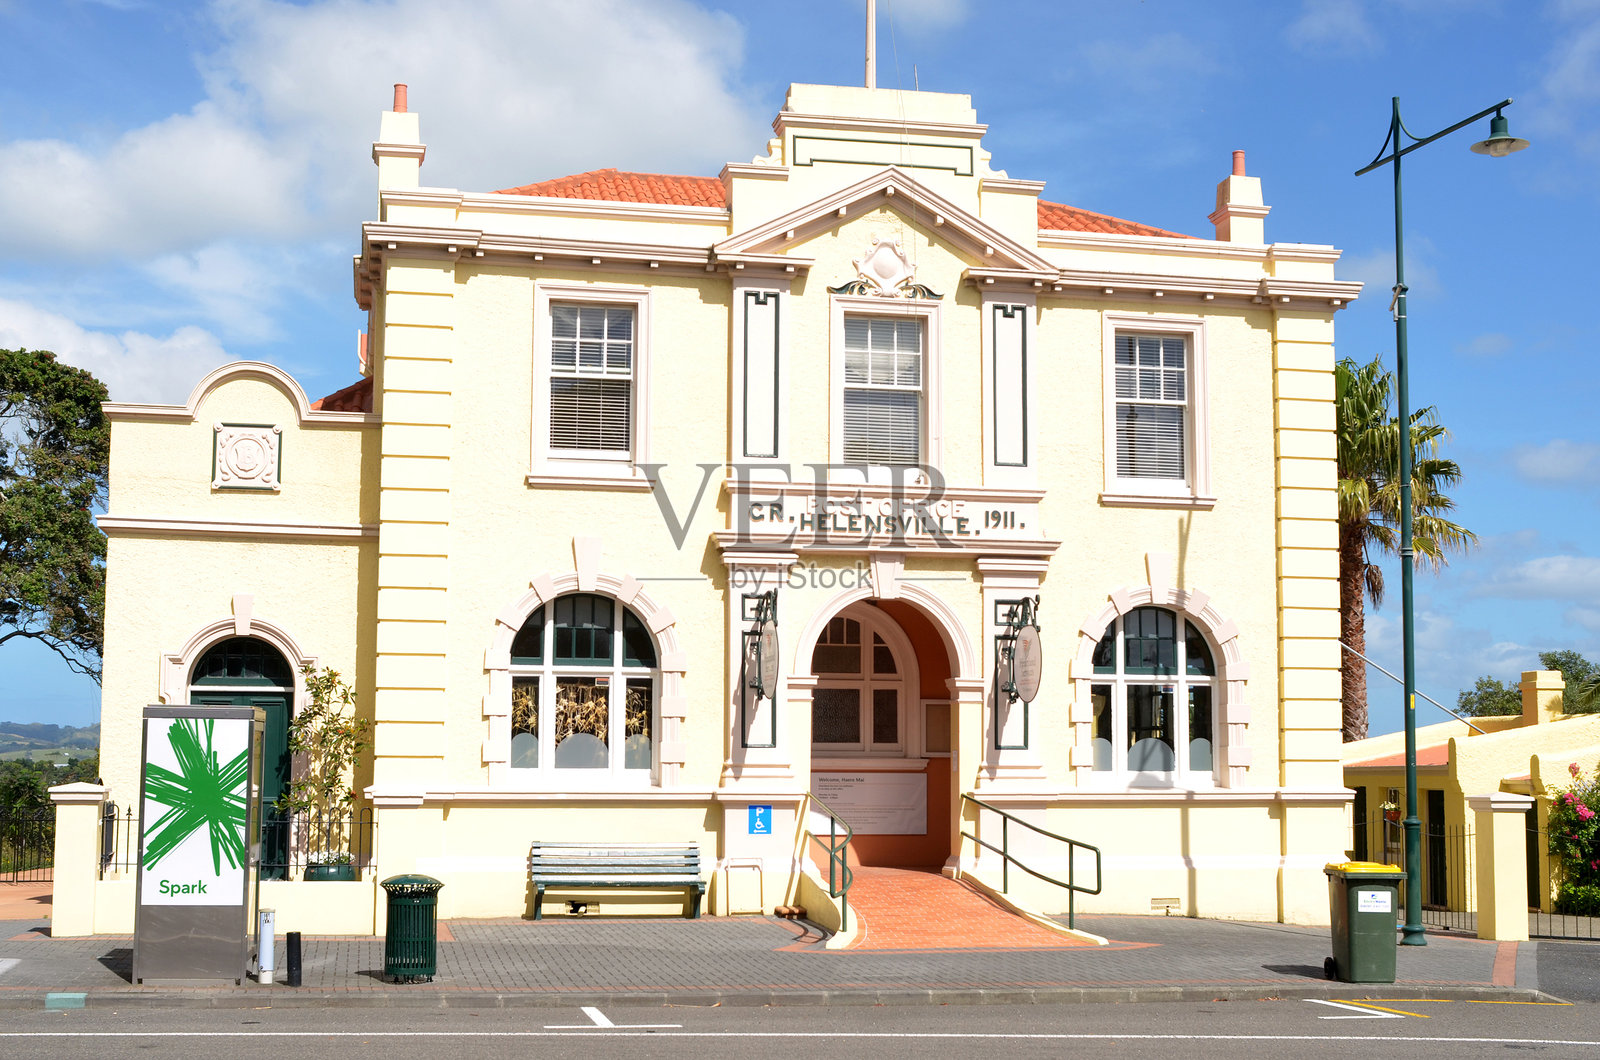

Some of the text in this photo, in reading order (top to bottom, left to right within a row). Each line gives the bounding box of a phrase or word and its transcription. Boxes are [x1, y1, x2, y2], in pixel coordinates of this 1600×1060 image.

[807, 496, 967, 520] POST OFFICE
[801, 513, 980, 536] HELENSVILLE.
[984, 510, 1026, 530] 1911.
[756, 807, 764, 816] P
[159, 879, 207, 897] Spark
